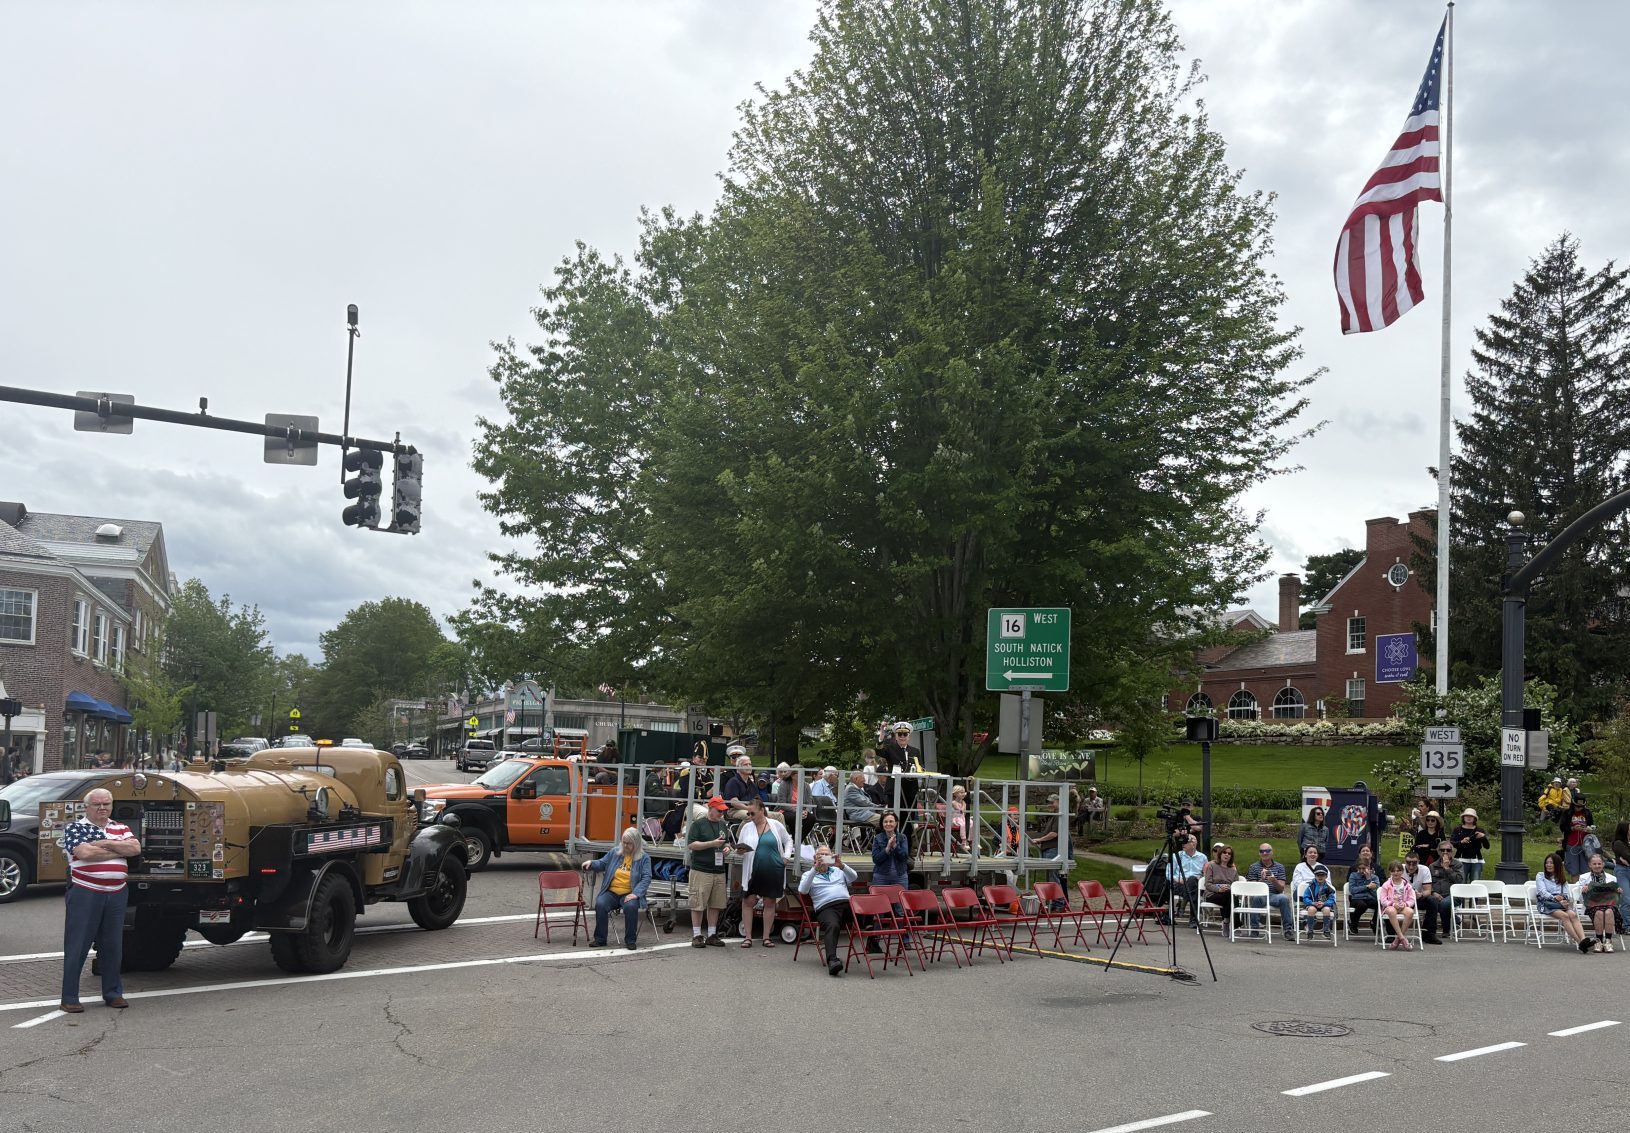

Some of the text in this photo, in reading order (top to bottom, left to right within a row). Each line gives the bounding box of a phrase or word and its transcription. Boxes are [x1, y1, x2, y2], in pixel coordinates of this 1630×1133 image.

[1005, 619, 1021, 633] 16
[994, 643, 1063, 653] SOUTH NATICK
[1003, 656, 1053, 667] HOLLISTON
[692, 720, 704, 731] 16
[1429, 730, 1455, 740] WEST
[1508, 733, 1520, 743] NO
[1506, 743, 1521, 752] TURN
[1059, 752, 1067, 760] IS
[1424, 750, 1459, 770] 135
[1512, 753, 1524, 762] RED
[193, 864, 207, 872] 323
